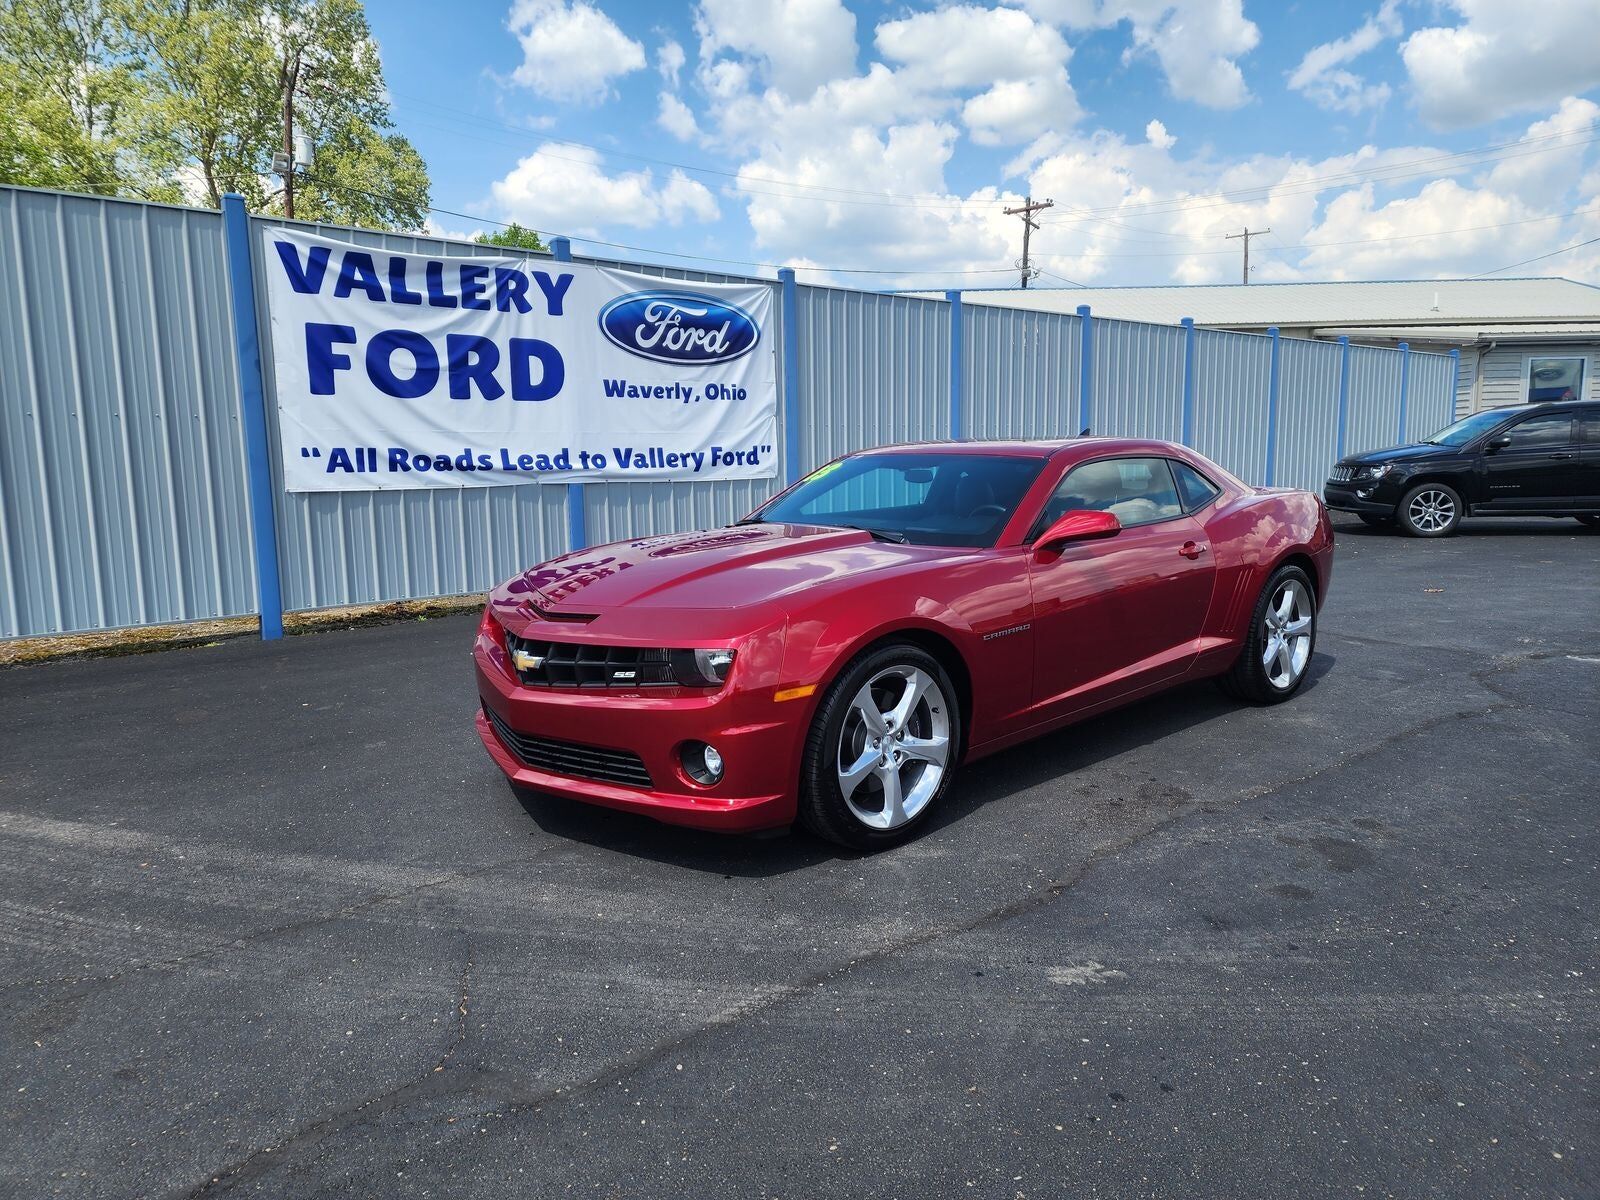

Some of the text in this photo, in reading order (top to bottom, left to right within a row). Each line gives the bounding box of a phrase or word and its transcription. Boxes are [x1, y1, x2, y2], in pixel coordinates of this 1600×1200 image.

[274, 241, 574, 317] VALLERY
[634, 300, 731, 354] Ford
[305, 322, 565, 402] FORD
[603, 380, 747, 403] Waverly, Ohio
[388, 447, 492, 472] Roads
[500, 448, 572, 472] Lead
[579, 450, 607, 471] to
[613, 447, 705, 473] Vallery
[983, 624, 1030, 640] CAMARO
